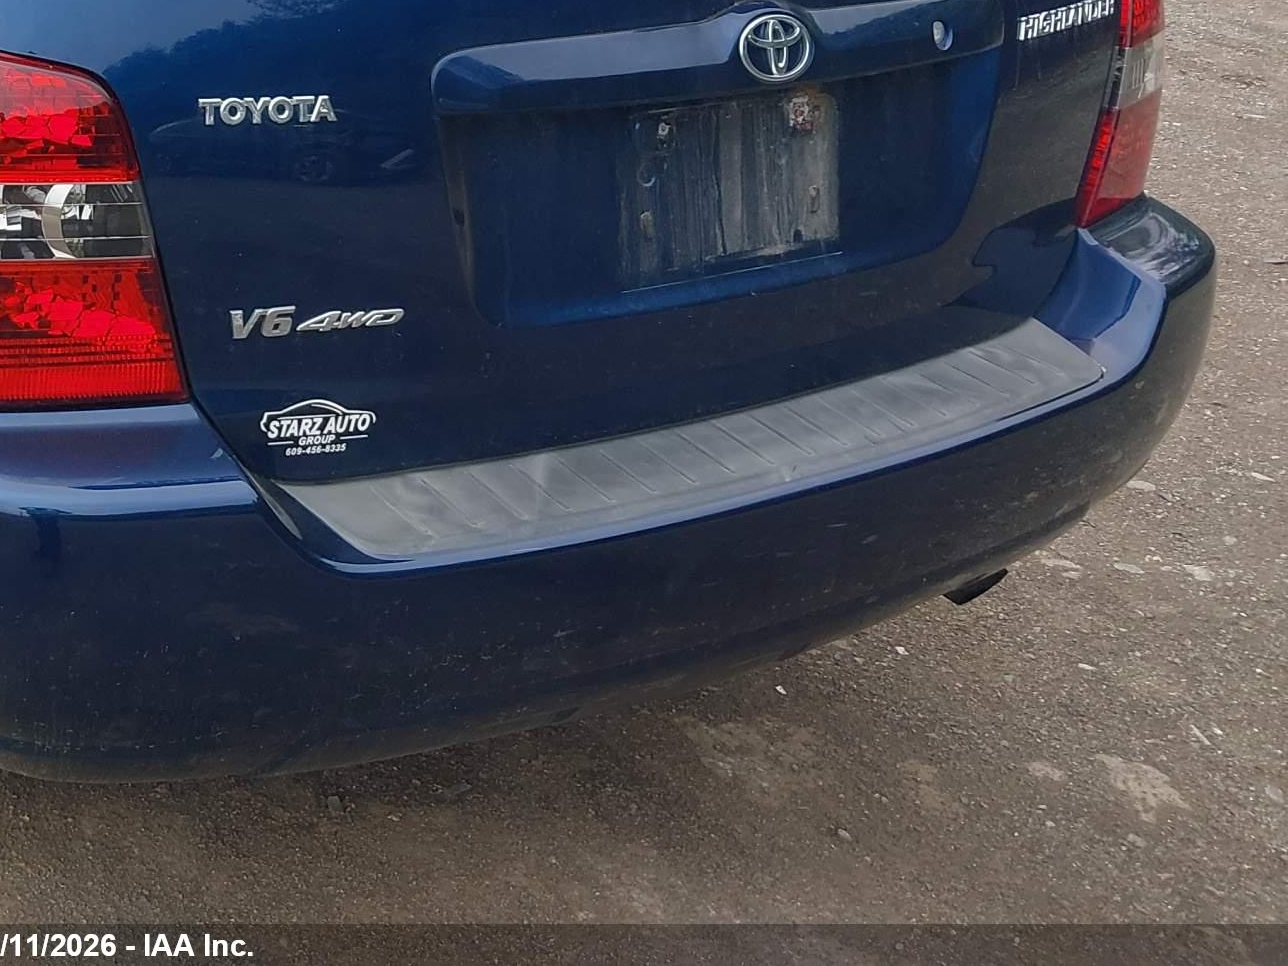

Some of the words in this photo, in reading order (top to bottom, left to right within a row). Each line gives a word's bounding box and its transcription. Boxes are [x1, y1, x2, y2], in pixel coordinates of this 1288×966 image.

[198, 95, 338, 126] TOYOTA
[229, 305, 297, 340] V6
[296, 308, 404, 332] 4WD
[267, 417, 323, 439] STARZ
[323, 413, 371, 435] AUTO
[285, 443, 347, 456] 609-456-8335
[298, 434, 336, 446] GROUP
